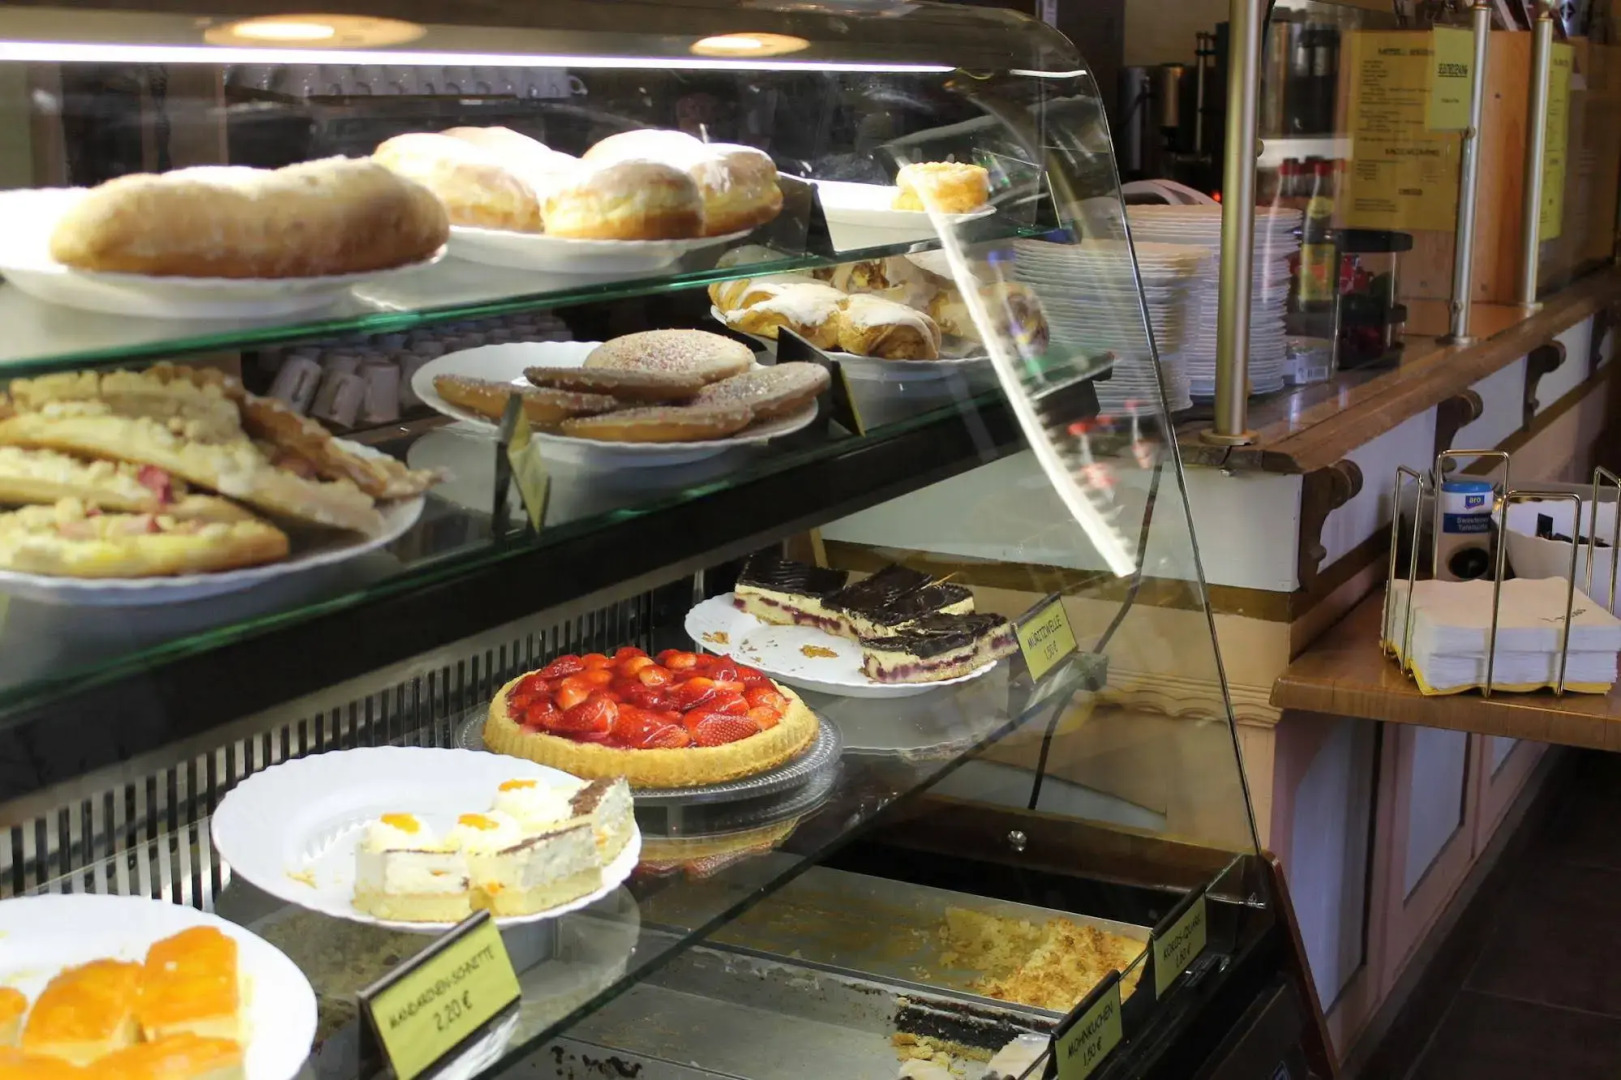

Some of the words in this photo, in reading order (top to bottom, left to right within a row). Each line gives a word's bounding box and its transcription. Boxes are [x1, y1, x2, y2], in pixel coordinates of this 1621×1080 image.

[433, 998, 462, 1032] 2,20
[463, 990, 473, 1010] €
[1067, 1000, 1114, 1060] MOHNKUCHEN
